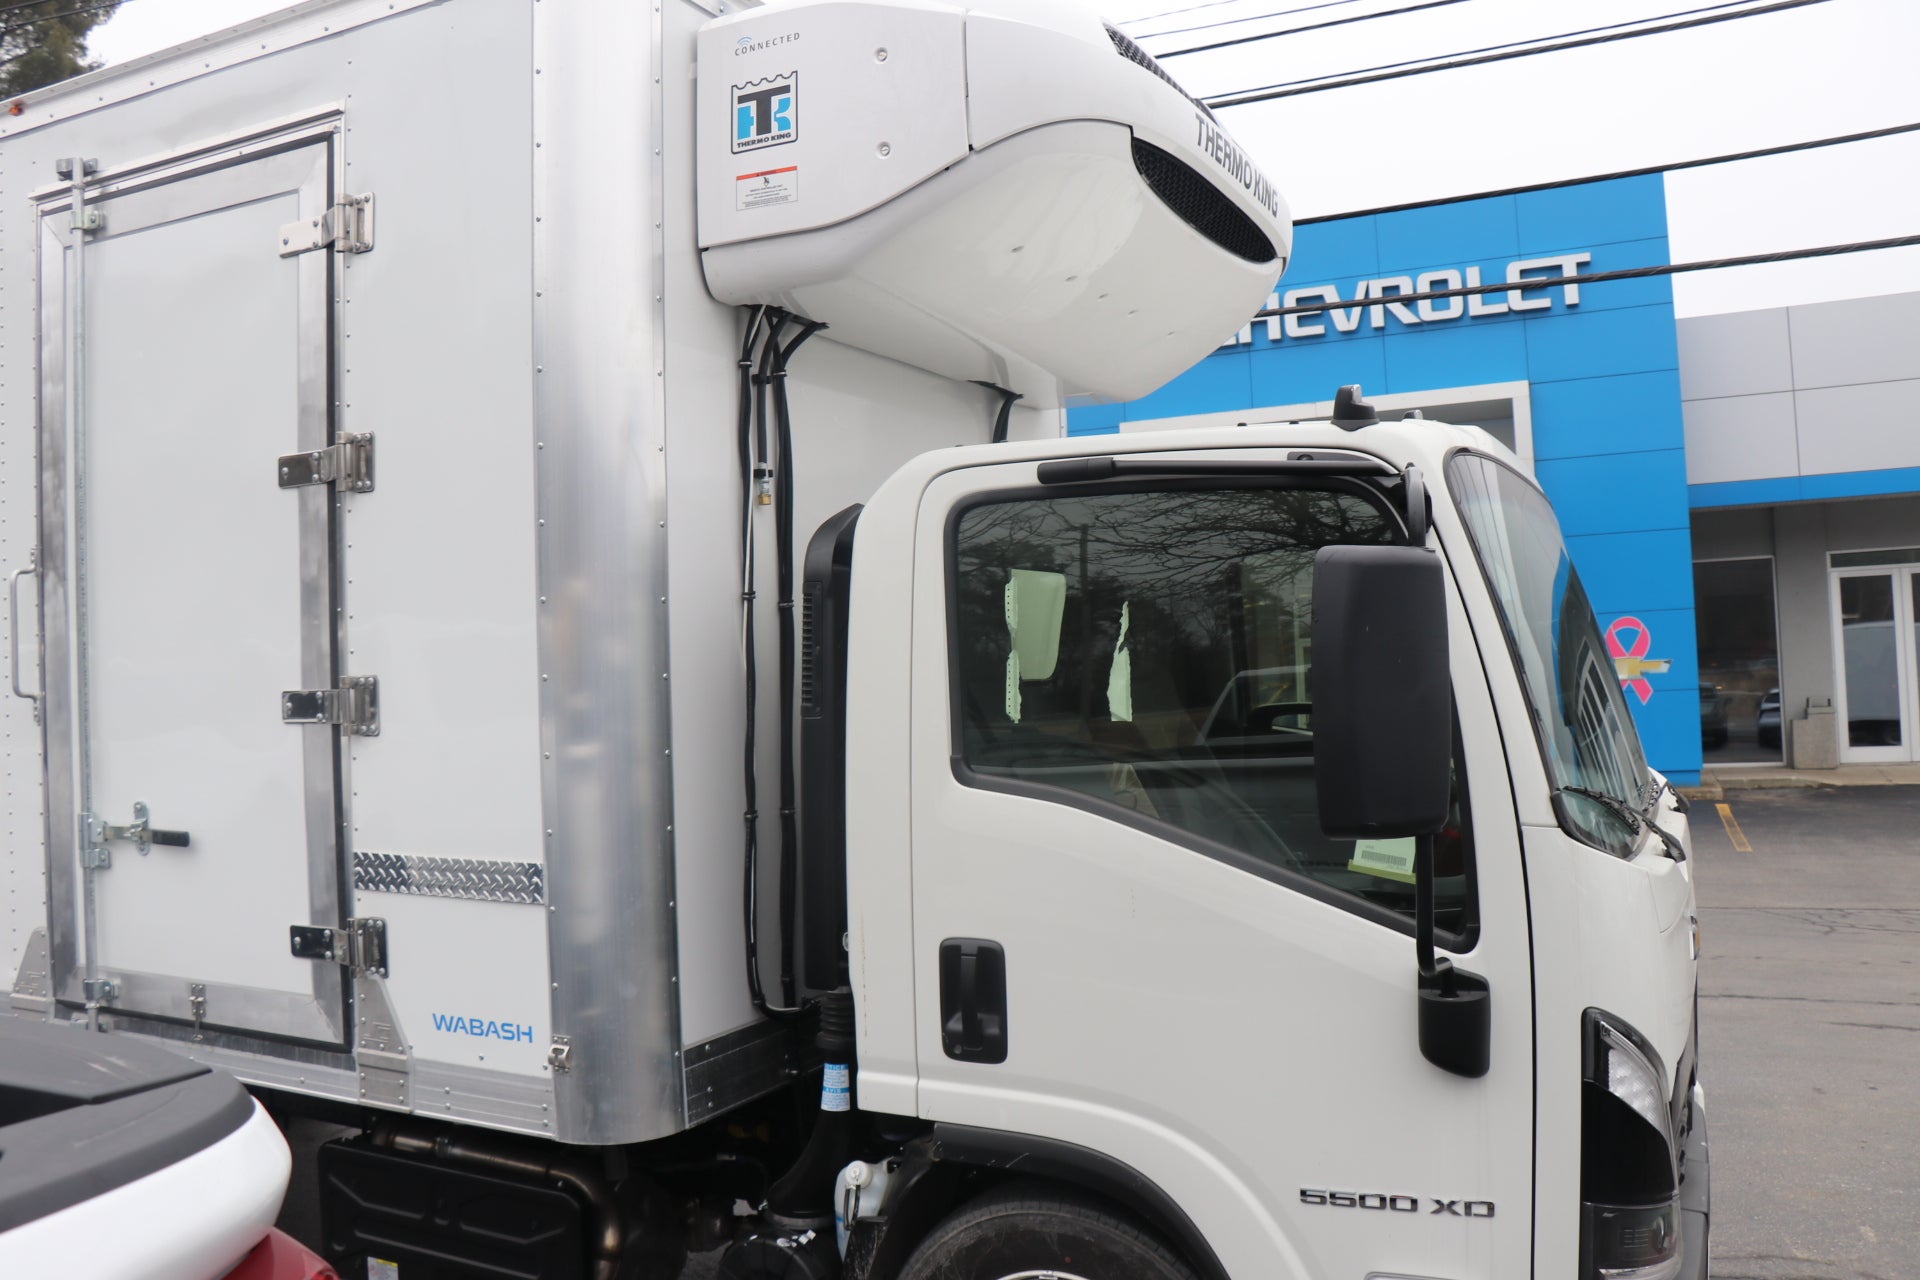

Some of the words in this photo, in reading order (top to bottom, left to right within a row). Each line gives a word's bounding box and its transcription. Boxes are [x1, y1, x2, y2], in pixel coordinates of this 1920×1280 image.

[734, 32, 800, 56] CONNECTED
[736, 136, 770, 148] THERMO
[770, 132, 791, 141] KING
[1195, 111, 1253, 190] THERMO
[1253, 168, 1279, 218] KING
[432, 1012, 534, 1044] WABASH
[1300, 1188, 1418, 1213] 5500
[1429, 1197, 1495, 1218] XD
